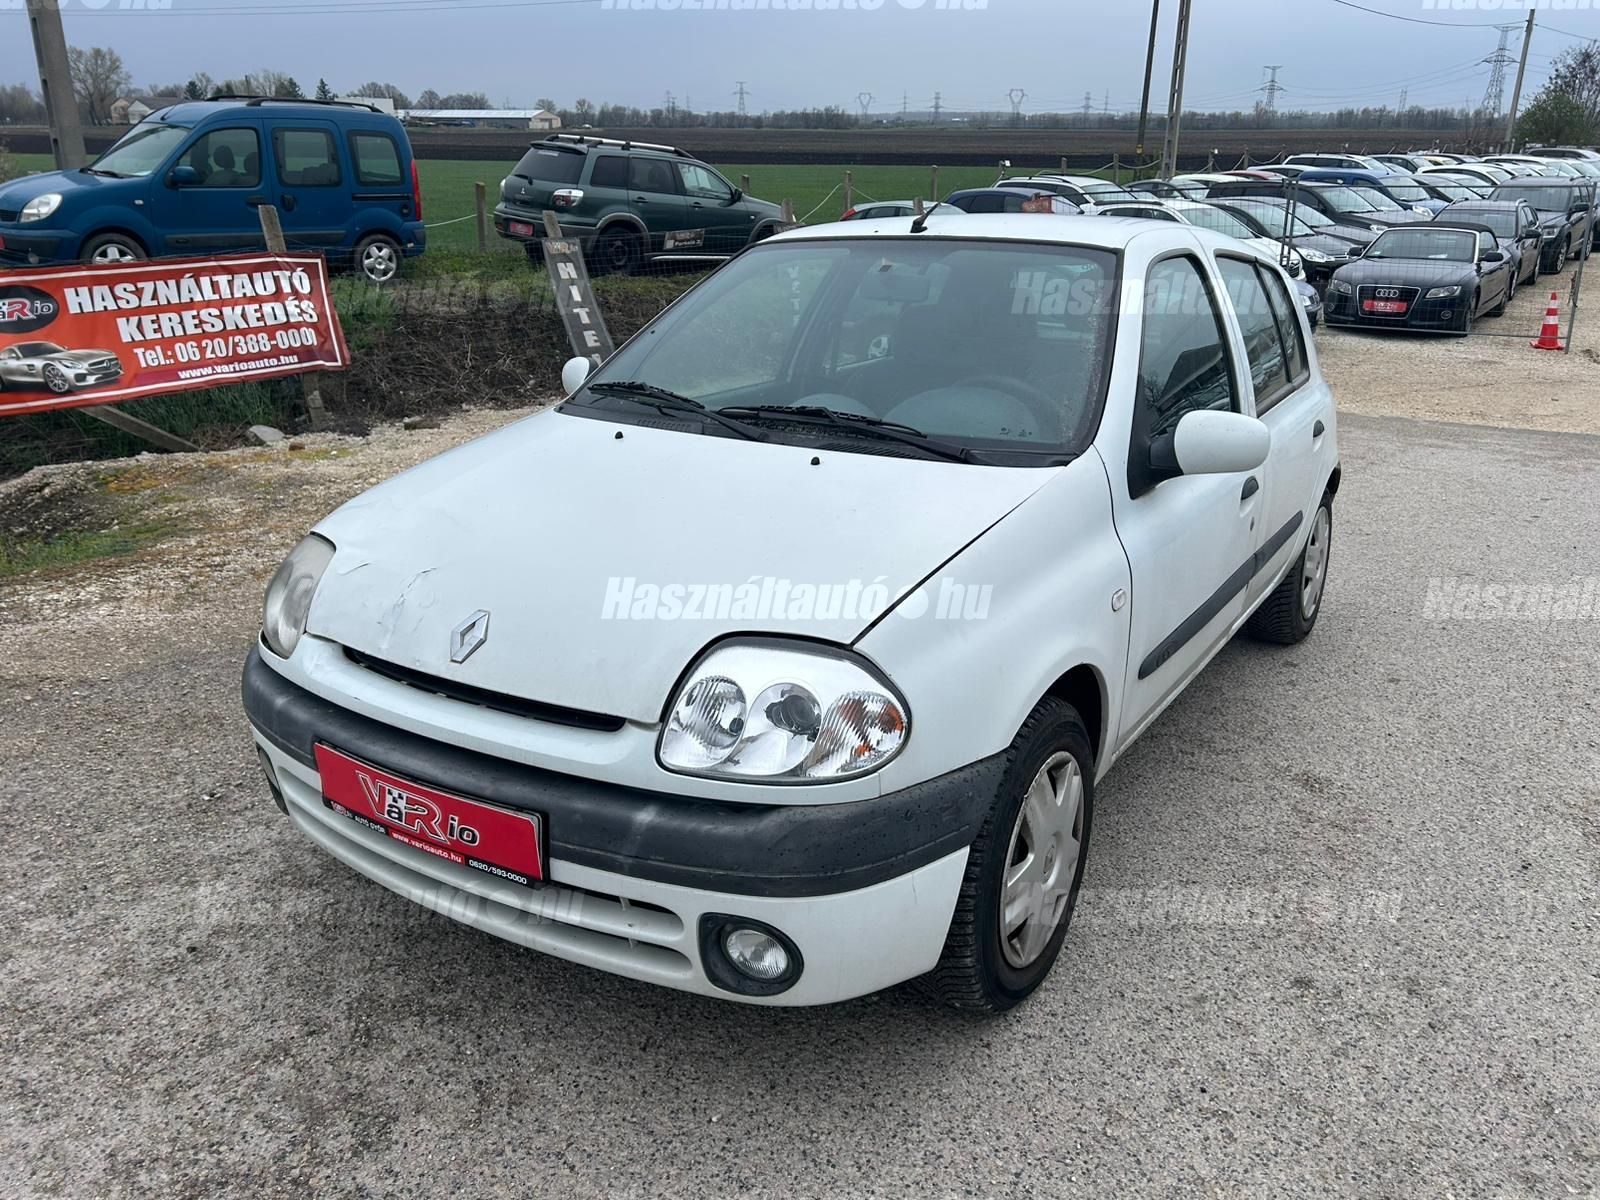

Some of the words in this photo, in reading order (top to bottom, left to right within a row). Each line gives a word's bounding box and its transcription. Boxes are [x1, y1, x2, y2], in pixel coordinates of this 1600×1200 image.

[64, 267, 311, 314] HASZNÁLTAUTÓ
[116, 296, 318, 343] KERESKEDÉS
[133, 346, 174, 368] Tel.:
[174, 341, 200, 363] 06
[178, 354, 299, 379] www.varioauto.hu
[391, 832, 462, 863] www.varioauto.hu
[469, 859, 527, 885] 0620/593-0000
